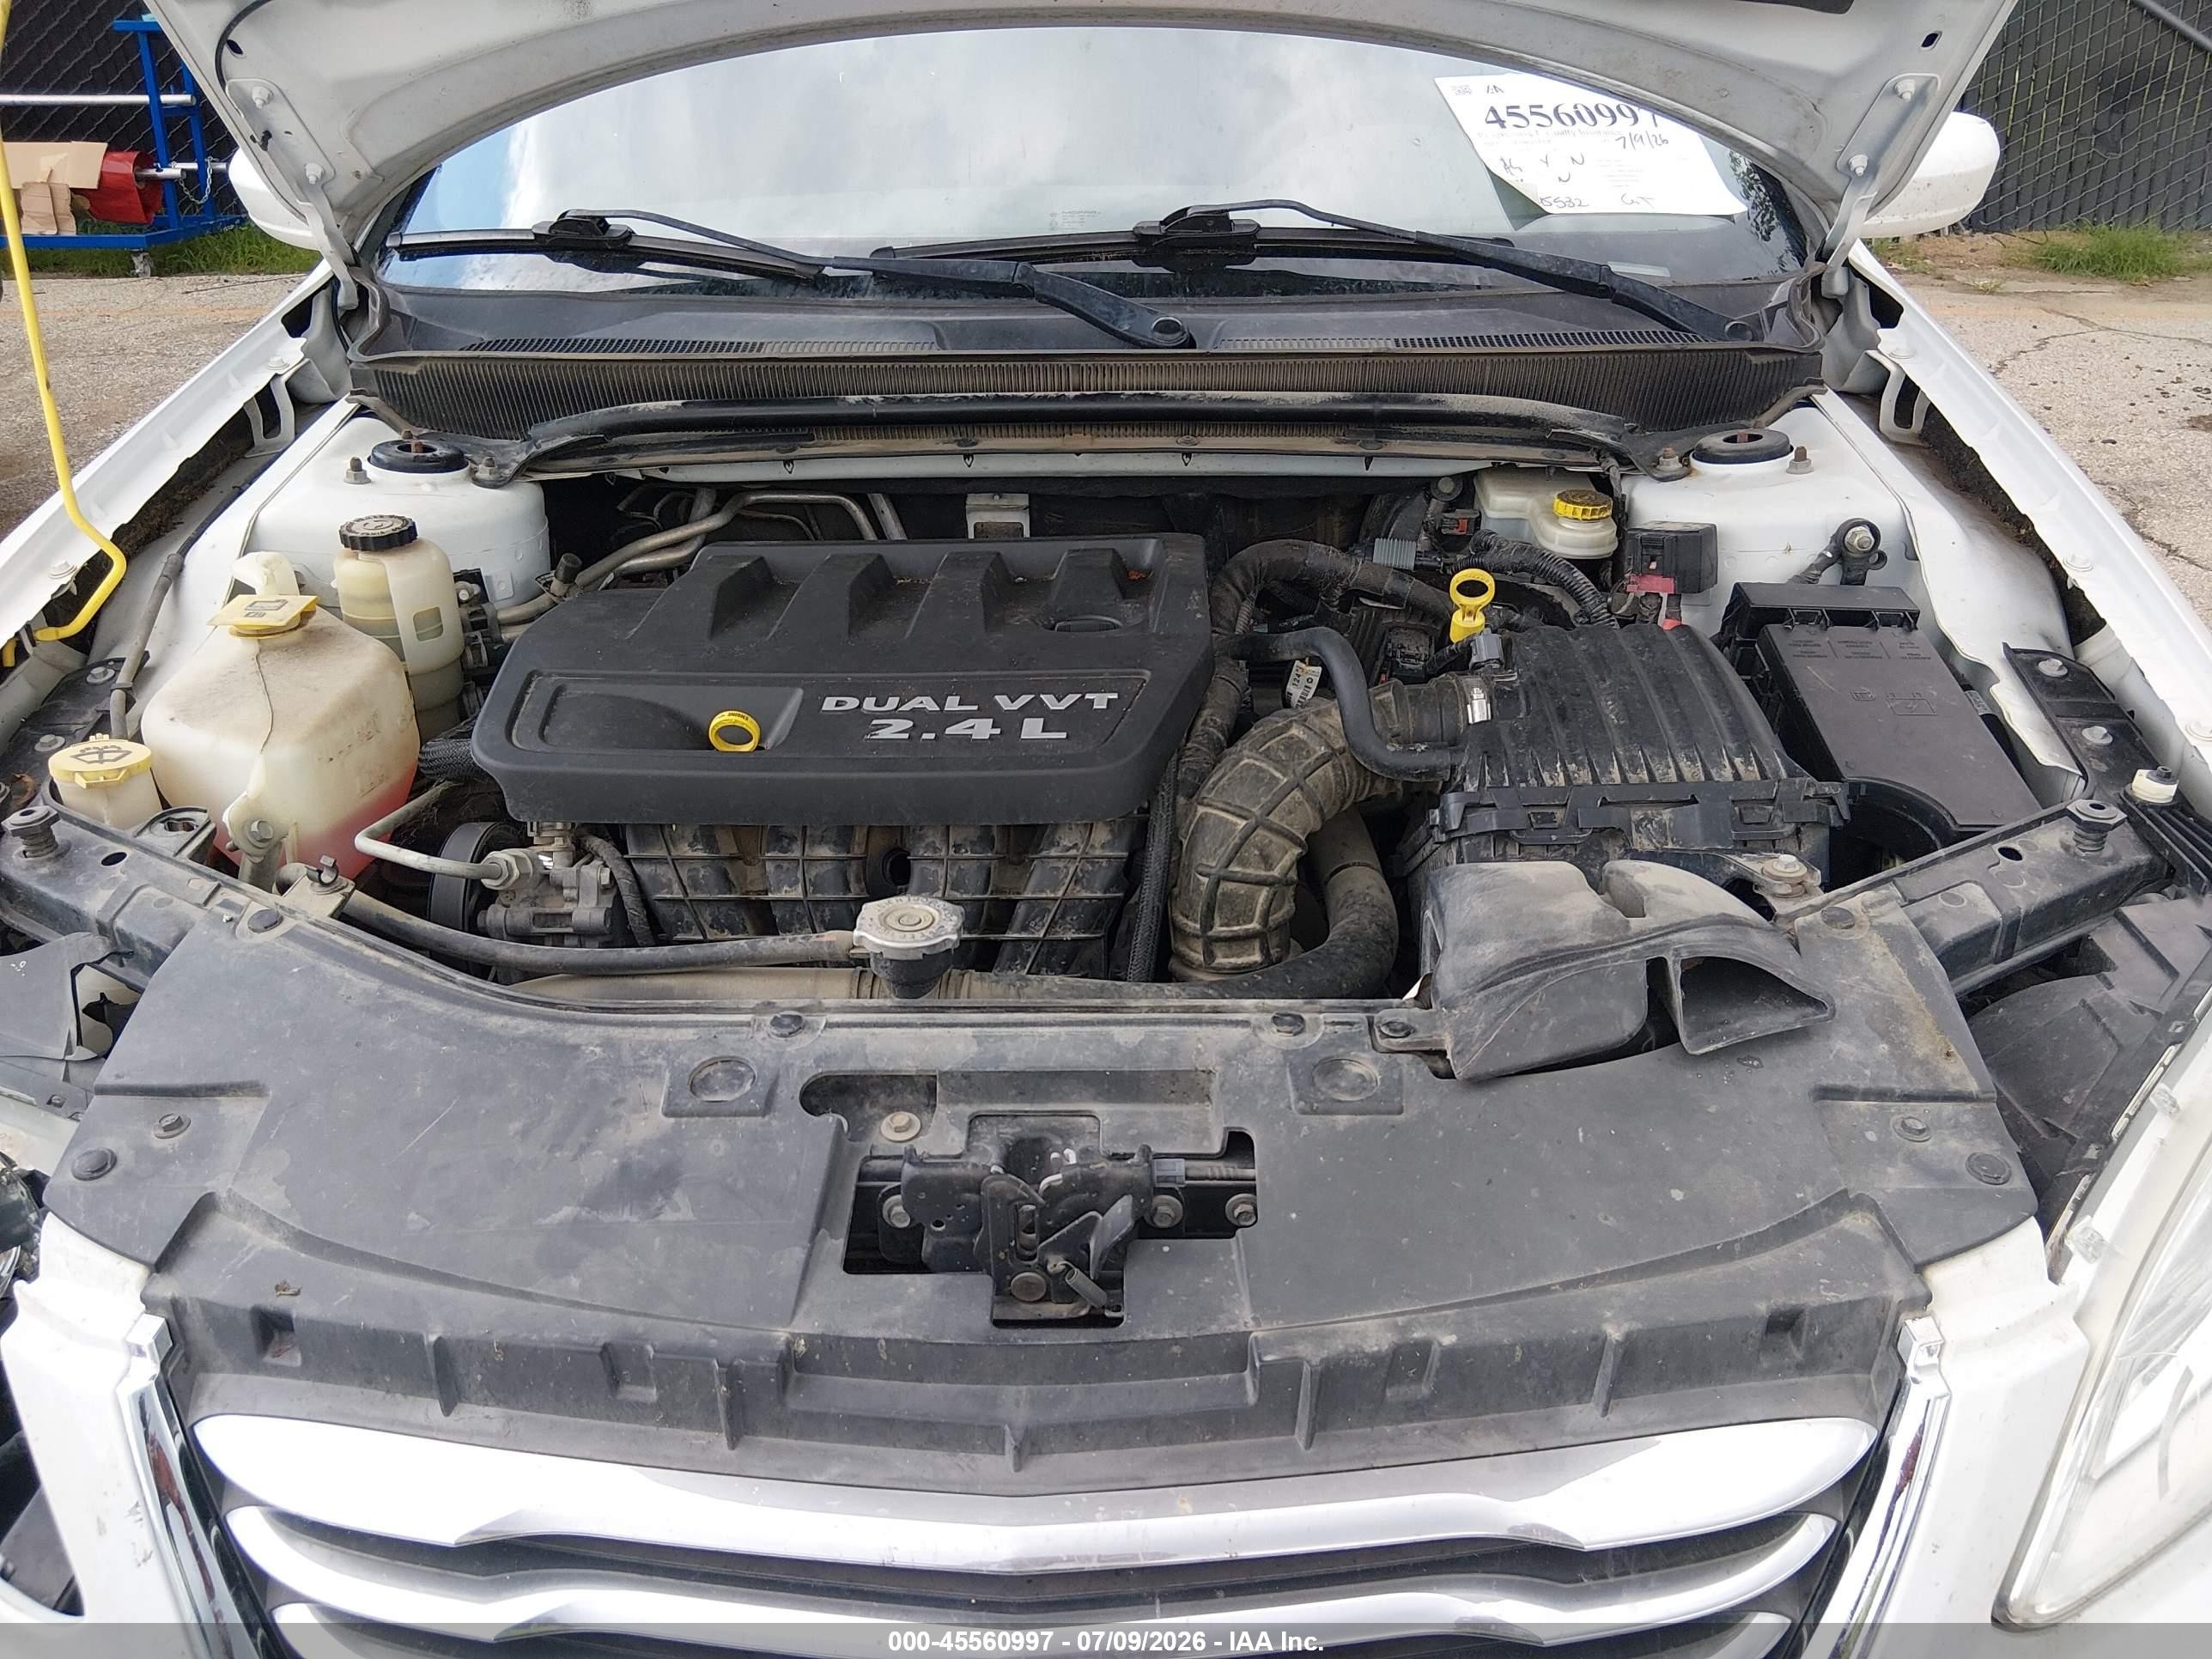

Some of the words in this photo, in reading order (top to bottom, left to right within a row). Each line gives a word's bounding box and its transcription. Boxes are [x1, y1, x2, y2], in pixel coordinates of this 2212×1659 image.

[1615, 130, 1669, 150] 7/9/26
[821, 695, 979, 712] DUAL
[994, 692, 1119, 711] VVT
